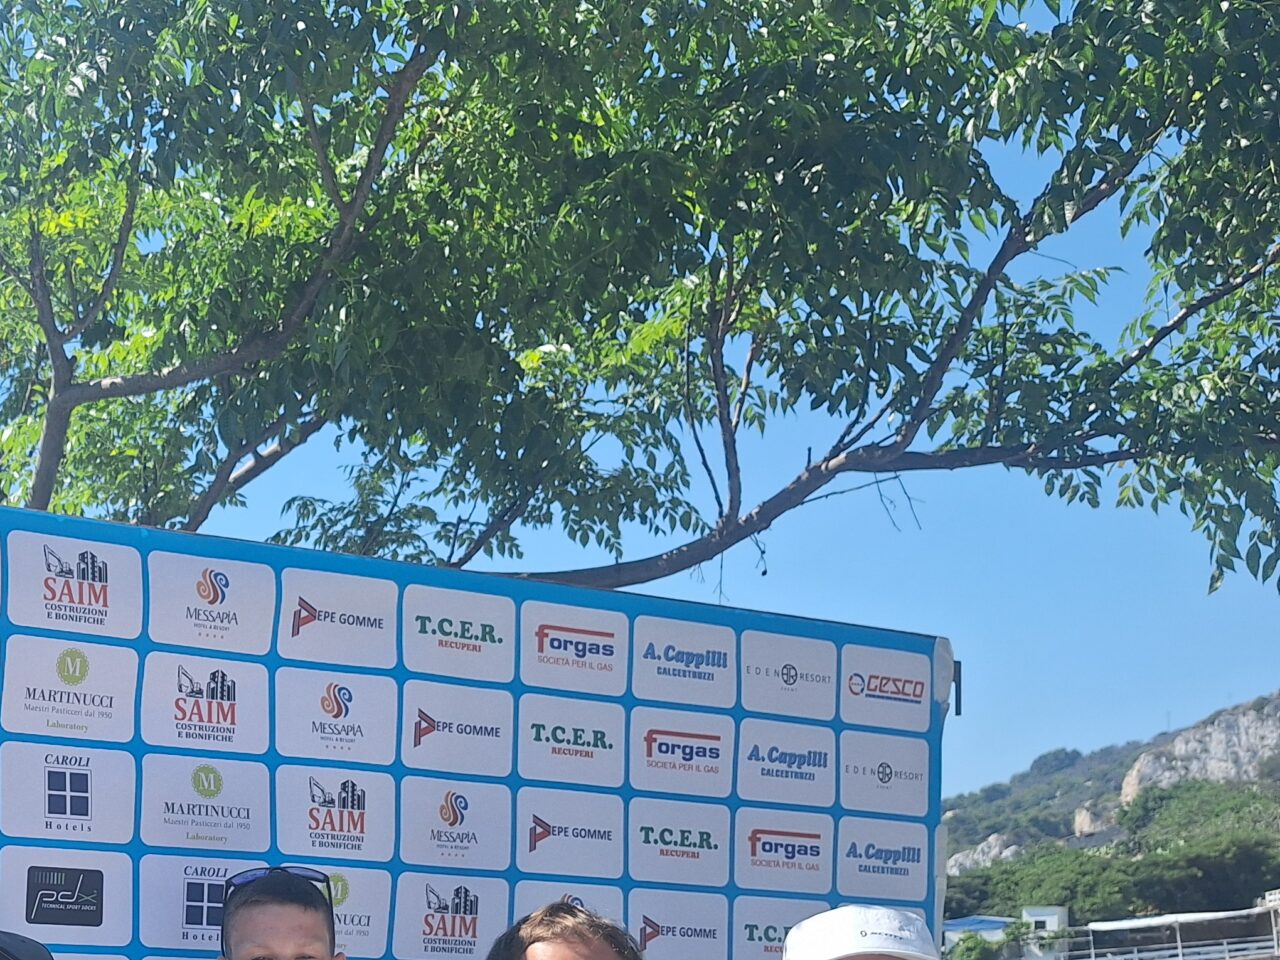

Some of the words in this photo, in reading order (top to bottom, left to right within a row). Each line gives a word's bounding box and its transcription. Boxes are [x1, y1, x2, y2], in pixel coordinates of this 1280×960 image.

[43, 576, 110, 608] SAIM
[44, 602, 108, 618] COSTRUZIONI
[54, 612, 106, 626] BONIFICHE
[339, 613, 384, 629] GOMME
[414, 614, 504, 644] T.C.E.R.
[438, 639, 482, 652] RECUPERI
[534, 623, 615, 659] forgas
[642, 642, 662, 660] A.
[571, 659, 586, 668] PER
[588, 661, 595, 669] IL
[596, 662, 614, 672] GAS
[746, 665, 780, 678] EDEN
[800, 673, 831, 684] RESORT
[866, 674, 925, 698] GESCO
[24, 686, 114, 709] MARTINUCCI
[174, 698, 236, 726] SAIM
[175, 723, 236, 735] COSTRUZIONI
[456, 724, 500, 738] GOMME
[530, 723, 614, 750] T.C.E.R.
[185, 732, 234, 743] BONIFICHE
[644, 728, 721, 762] forgas
[44, 753, 90, 768] CAROLI
[747, 744, 765, 762] A.
[678, 762, 694, 771] PER
[695, 764, 702, 772] IL
[703, 764, 720, 774] GAS
[845, 765, 876, 776] EDEN
[894, 771, 924, 781] RESORT
[162, 802, 250, 820] MARTINUCCI
[44, 821, 92, 833] Hotels
[308, 807, 366, 834] SAIM
[309, 832, 365, 843] COSTRUZIONI
[572, 826, 612, 841] GOMME
[640, 826, 719, 850] T.C.E.R.
[318, 840, 362, 850] BONIFICHE
[748, 828, 821, 860] forgas
[846, 842, 863, 859] A.
[184, 865, 228, 878] CAROLI
[781, 861, 796, 870] PER
[797, 862, 804, 870] IL
[805, 862, 820, 872] GAS
[422, 913, 478, 939] SAIM
[678, 926, 718, 940] GOMME
[422, 938, 476, 948] COSTRUZIONI
[430, 946, 474, 955] BONIFICHE
